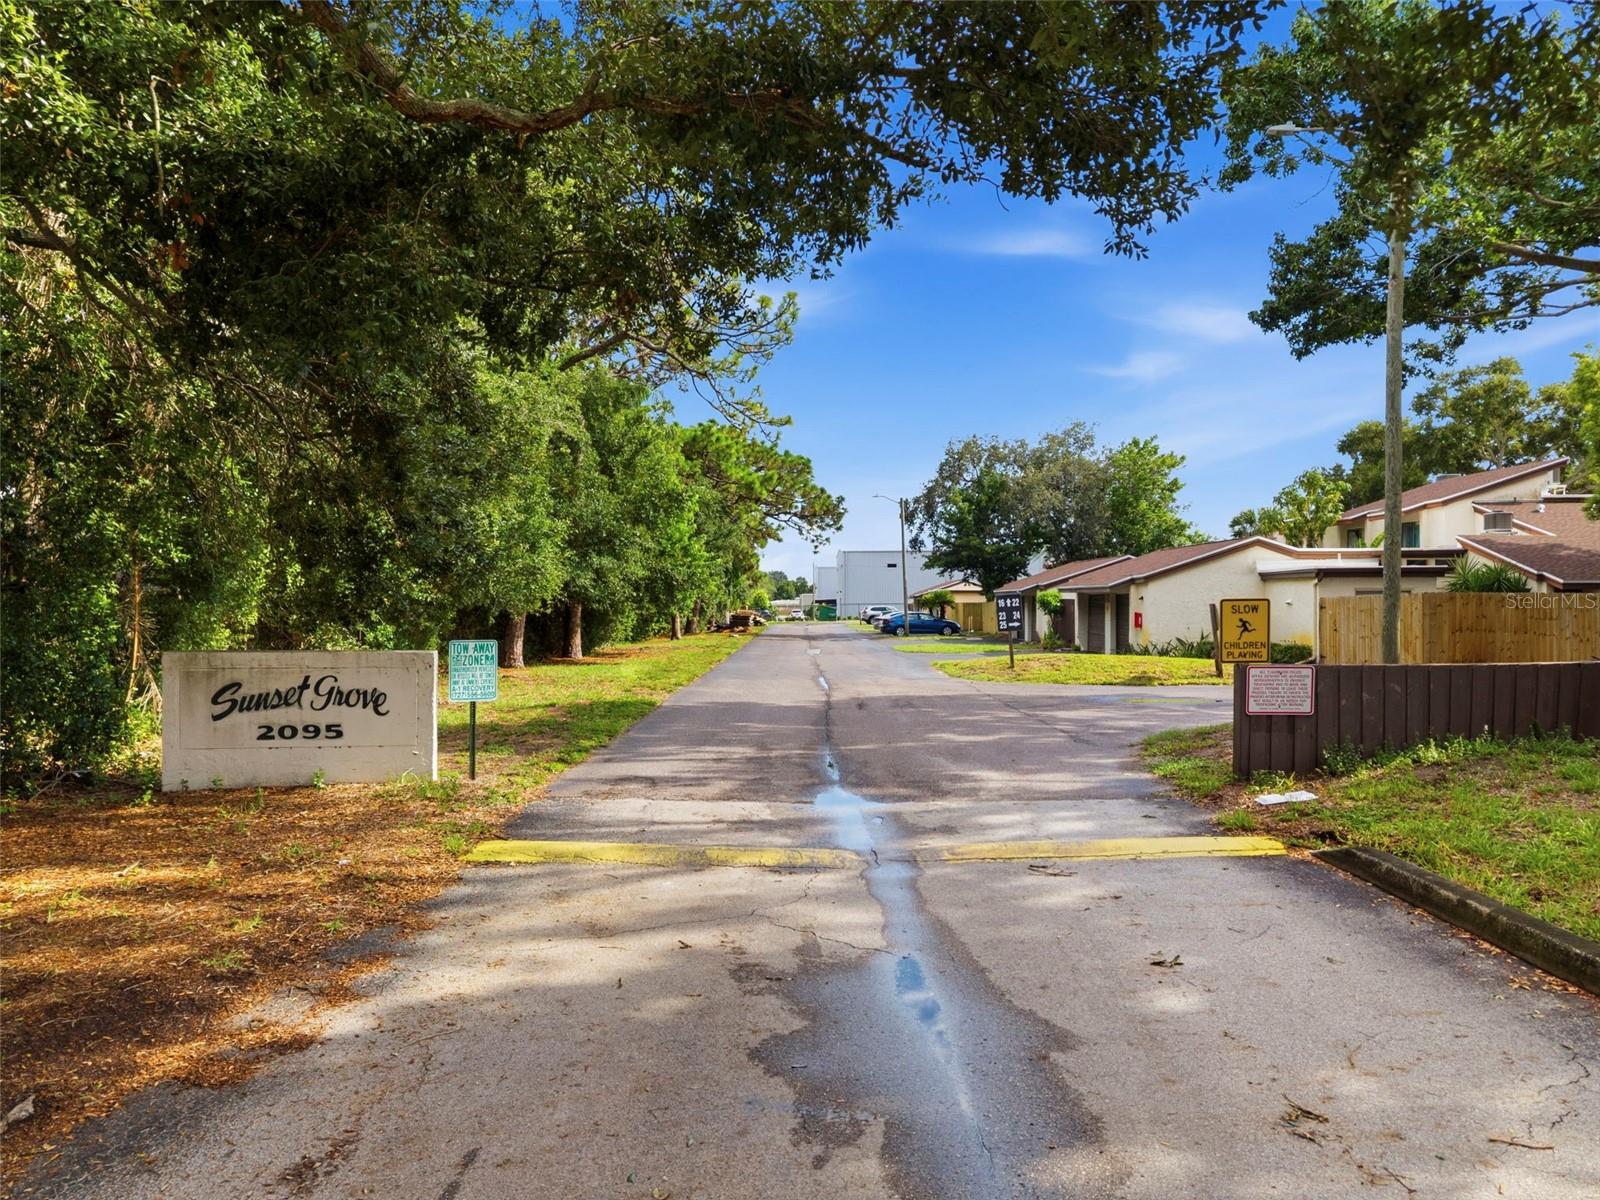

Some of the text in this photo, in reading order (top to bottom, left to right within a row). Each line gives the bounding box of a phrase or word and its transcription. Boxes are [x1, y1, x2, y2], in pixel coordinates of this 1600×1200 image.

[1012, 598, 1019, 606] 22
[1231, 604, 1259, 614] SLOW
[999, 611, 1020, 620] 23 24
[452, 643, 495, 654] TOW AWAY
[1224, 641, 1266, 650] CHILDREN
[1226, 650, 1263, 659] PLAYING
[462, 654, 484, 666] ZONE
[211, 675, 390, 721] Sunset Grove
[256, 724, 344, 741] 2095
